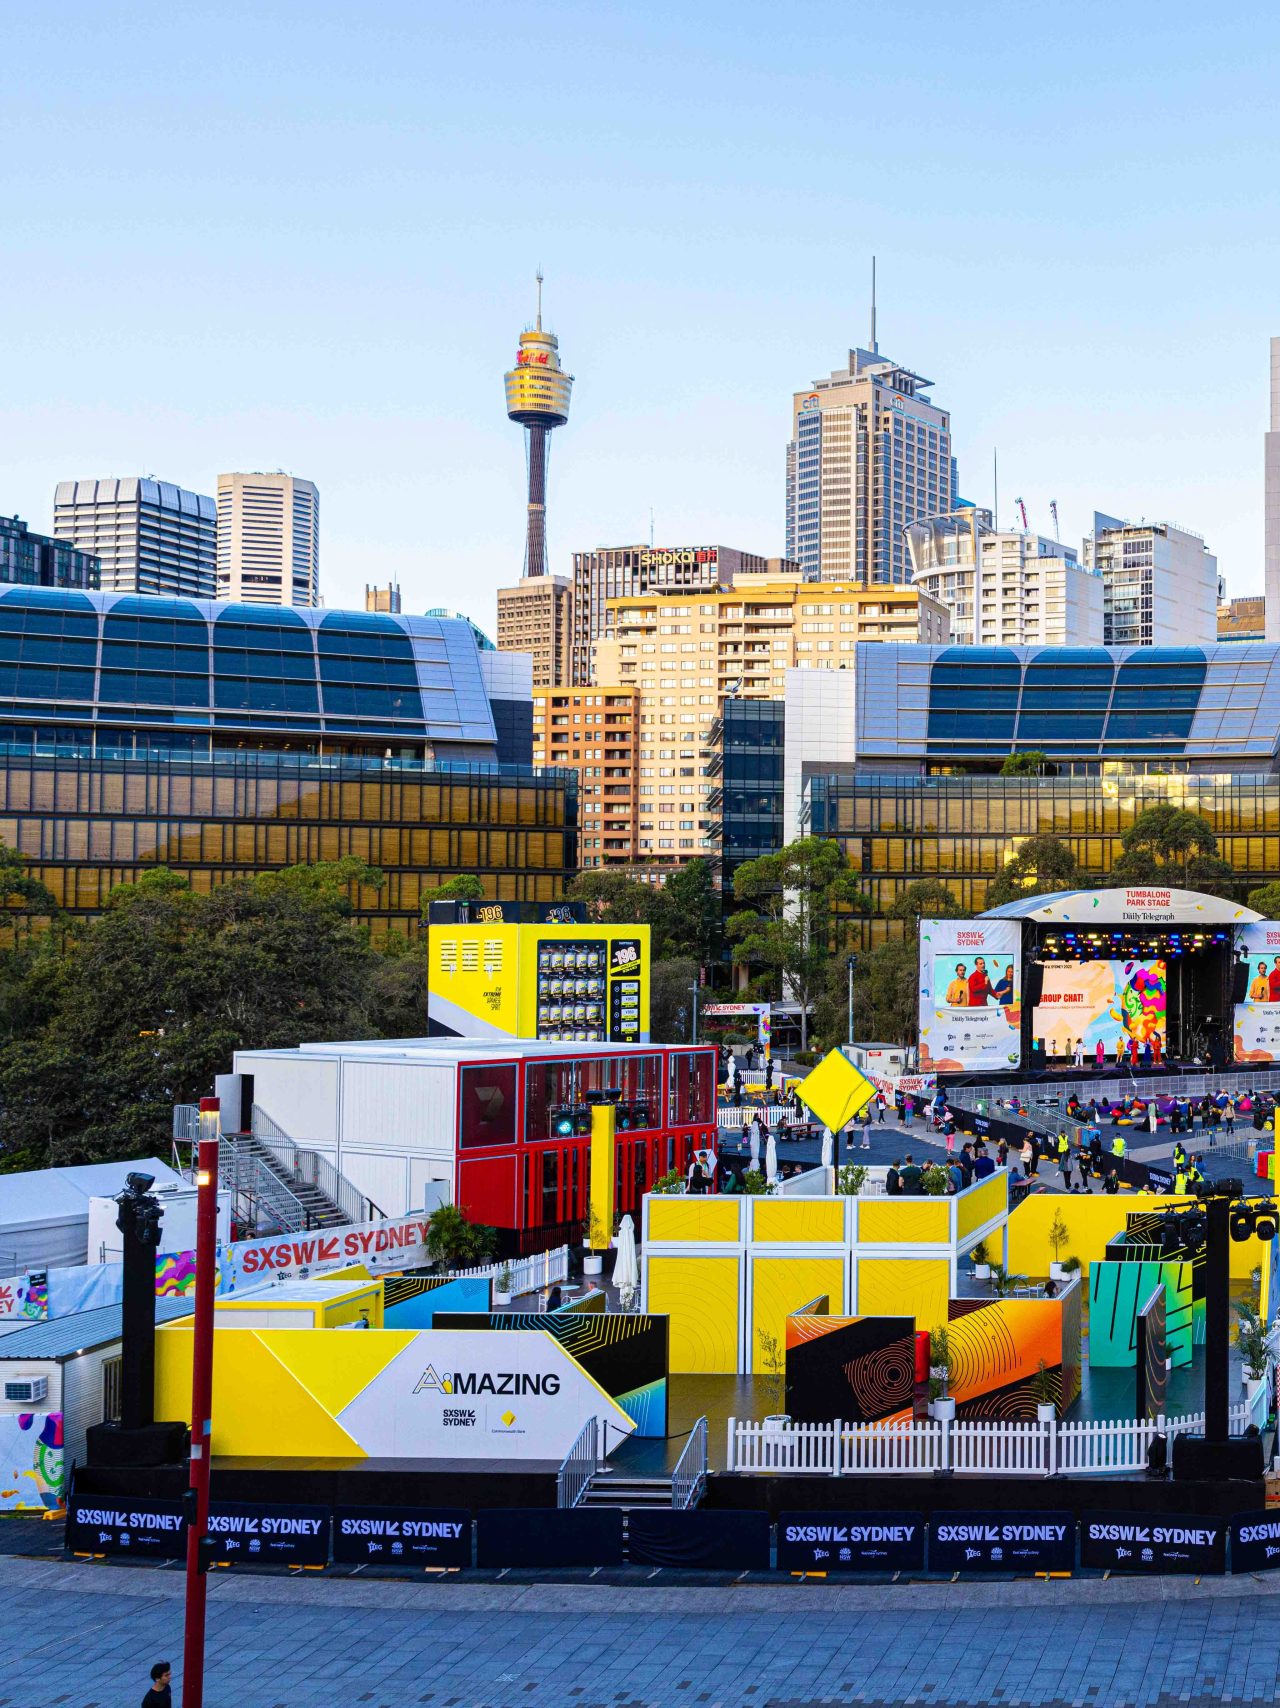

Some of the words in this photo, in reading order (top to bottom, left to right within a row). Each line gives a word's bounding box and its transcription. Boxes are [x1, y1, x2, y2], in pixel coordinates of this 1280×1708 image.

[1126, 890, 1171, 899] TUMBALONG
[1126, 898, 1147, 906] PARK
[1148, 899, 1170, 907] STAGE
[1122, 912, 1141, 921] Daily
[1141, 913, 1175, 922] Telegraph
[1040, 993, 1062, 1002] GROUP
[1063, 993, 1084, 1002] CHAT!
[242, 1240, 316, 1273] SXSW
[344, 1221, 432, 1256] SYDNEY
[443, 1409, 467, 1418] SXSW
[443, 1418, 477, 1426] SYDNEY
[76, 1508, 115, 1526] SXSW
[129, 1512, 183, 1531] SYDNEY
[207, 1516, 244, 1532] SXSW
[261, 1517, 322, 1535] SYDNEY
[341, 1519, 386, 1535] SXSW
[402, 1521, 463, 1538] SYDNEY
[786, 1526, 832, 1542] SXSW
[850, 1526, 915, 1542] SYDNEY
[937, 1525, 984, 1541] SXSW
[1002, 1525, 1066, 1541] SYDNEY
[1089, 1524, 1135, 1541] SXSW
[1153, 1527, 1217, 1546] SYDNEY
